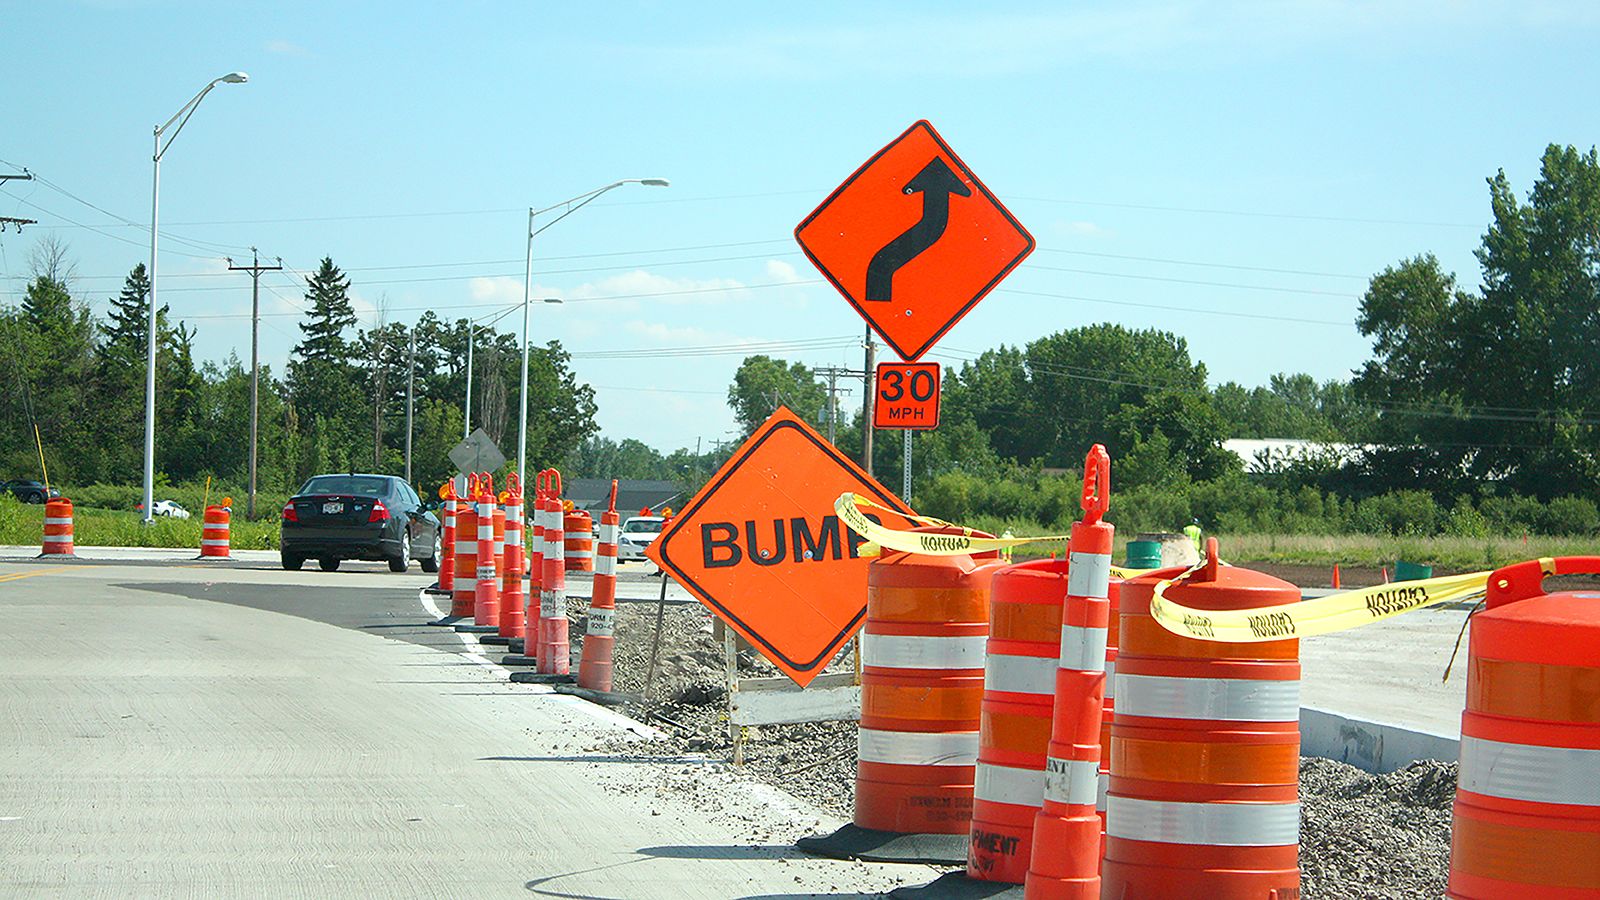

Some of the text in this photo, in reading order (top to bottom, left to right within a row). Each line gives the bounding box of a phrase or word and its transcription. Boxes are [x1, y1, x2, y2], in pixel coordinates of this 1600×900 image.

[881, 370, 935, 402] 30
[889, 407, 924, 420] MPH
[1365, 586, 1430, 617] CAUTION
[1247, 612, 1296, 638] CAUTION
